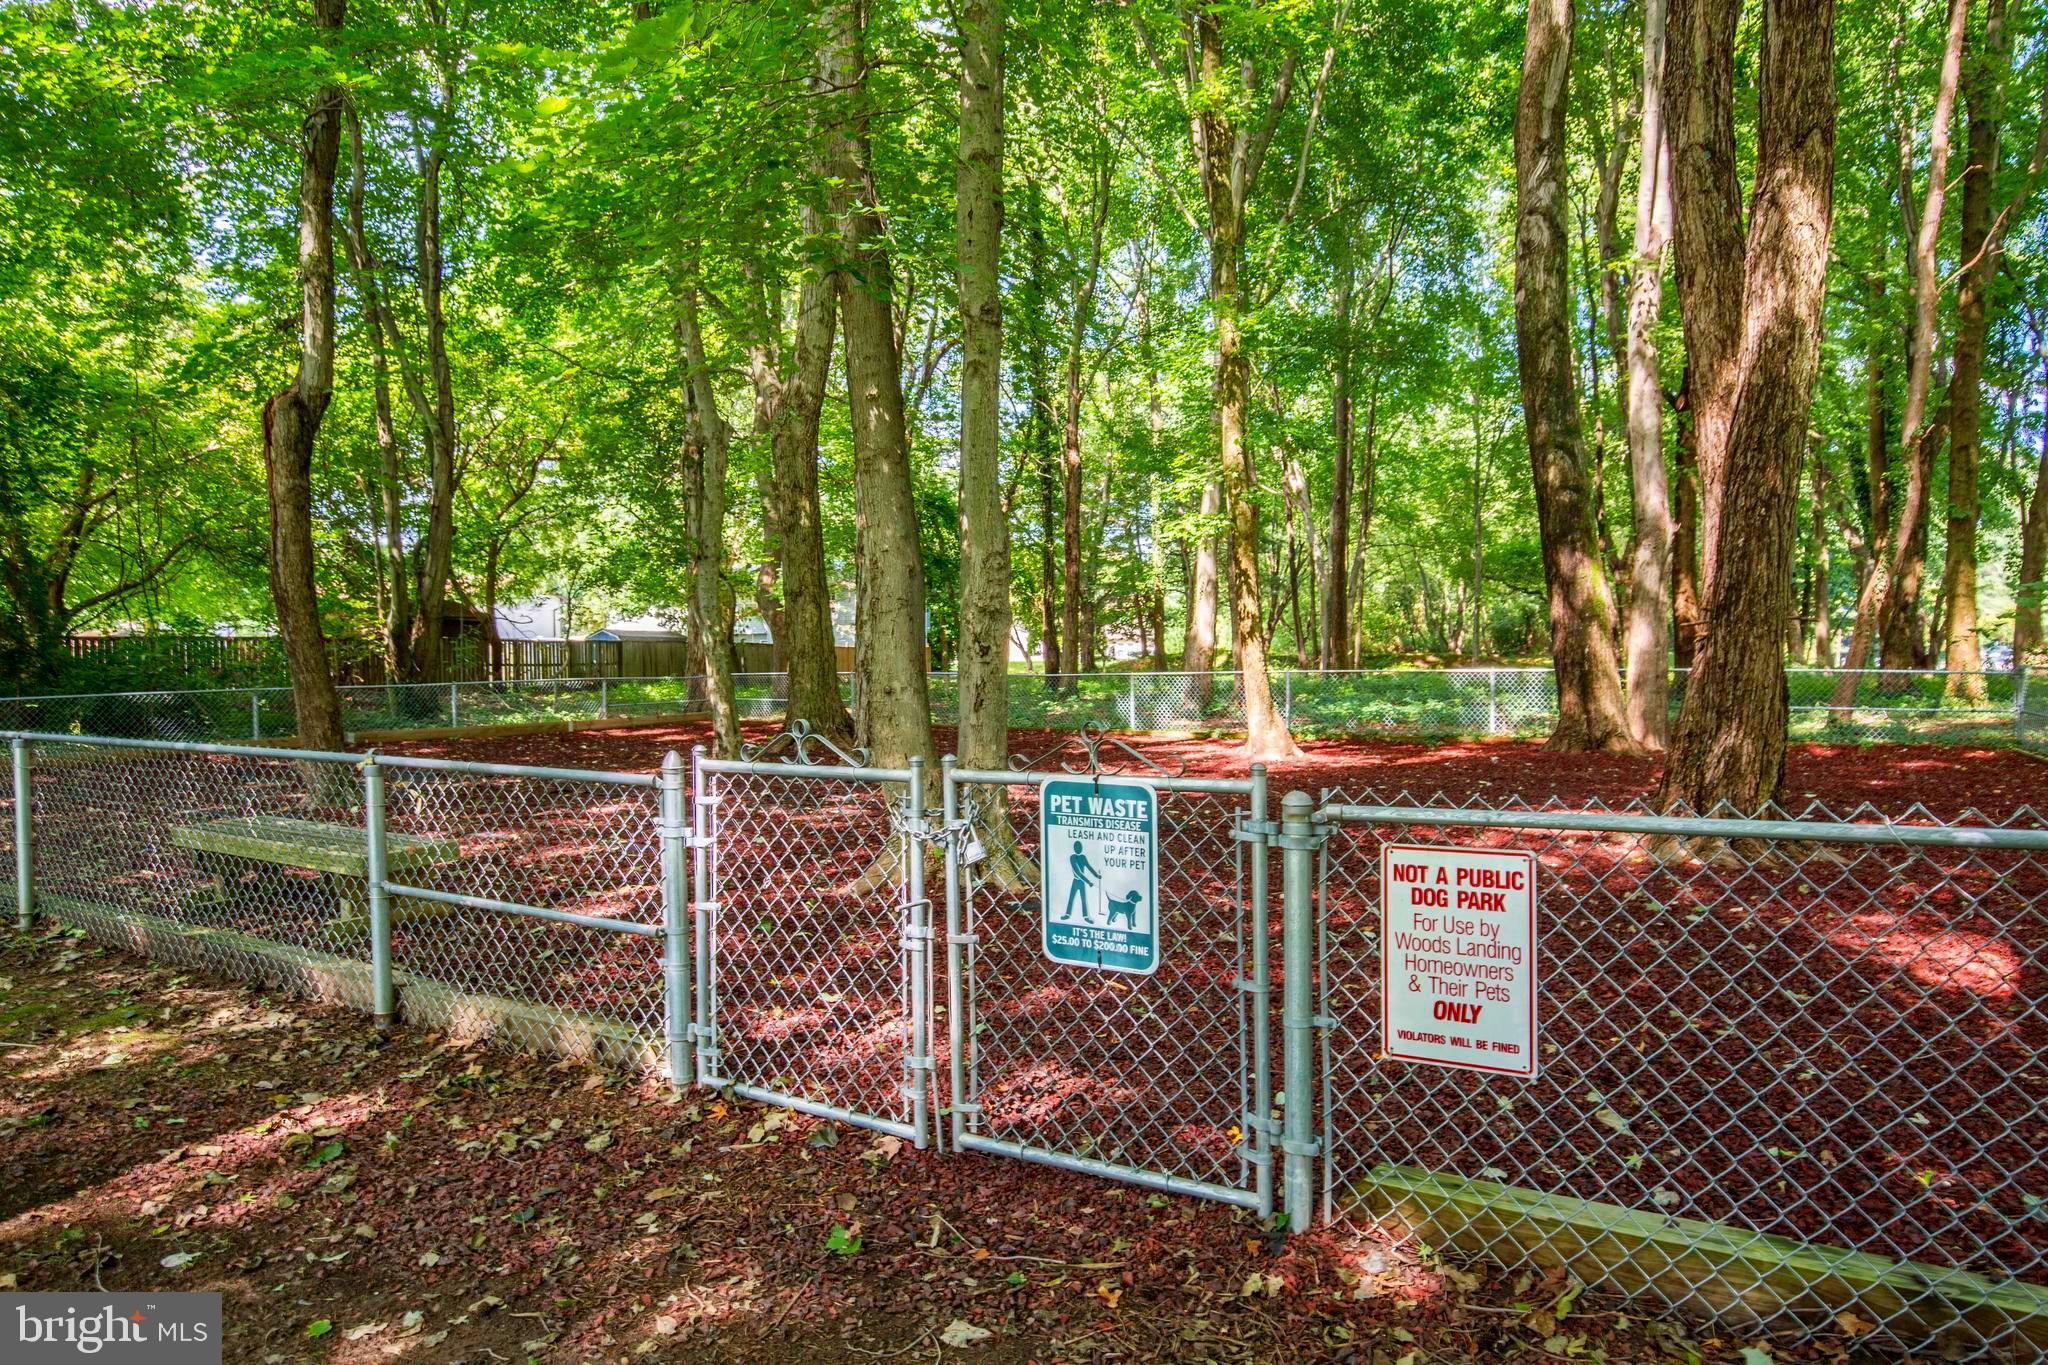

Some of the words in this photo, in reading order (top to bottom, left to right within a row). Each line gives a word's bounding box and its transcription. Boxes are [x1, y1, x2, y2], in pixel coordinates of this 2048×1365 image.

[1051, 795, 1083, 813] PET
[1088, 797, 1147, 818] WASTE
[1057, 816, 1103, 828] TRANSMITS
[1106, 820, 1141, 831] DISEASE
[1068, 829, 1094, 839] LEASH
[1097, 832, 1114, 841] AND
[1117, 834, 1145, 844] CLEAN
[1104, 846, 1115, 854] UP
[1118, 847, 1145, 857] AFTER
[1104, 858, 1126, 868] YOUR
[1130, 860, 1145, 870] PET
[1393, 864, 1428, 883] NOT
[1436, 867, 1448, 884] A
[1456, 868, 1524, 890] PUBLIC
[1411, 887, 1448, 907] DOG
[1457, 891, 1506, 912] PARK
[1073, 928, 1088, 937] IT'S
[1090, 930, 1105, 940] THE
[1107, 932, 1127, 942] LAW!
[1414, 913, 1438, 932] For
[1443, 915, 1474, 936] Use
[1480, 918, 1500, 941] by
[1052, 934, 1079, 946] $25.00
[1082, 938, 1092, 948] TO
[1094, 940, 1128, 953] $200.00
[1130, 945, 1149, 956] FINE
[1395, 932, 1451, 954] Woods
[1457, 938, 1522, 965] Landing
[1405, 953, 1514, 981] Homeowners
[1408, 975, 1421, 992] &
[1428, 976, 1468, 997] Their
[1476, 981, 1510, 1002] Pets
[1433, 1000, 1482, 1024] ONLY
[1397, 1029, 1446, 1045] VIOLATORS
[1450, 1037, 1472, 1048] WILL
[1476, 1040, 1488, 1050] BE
[1492, 1042, 1520, 1054] FINED
